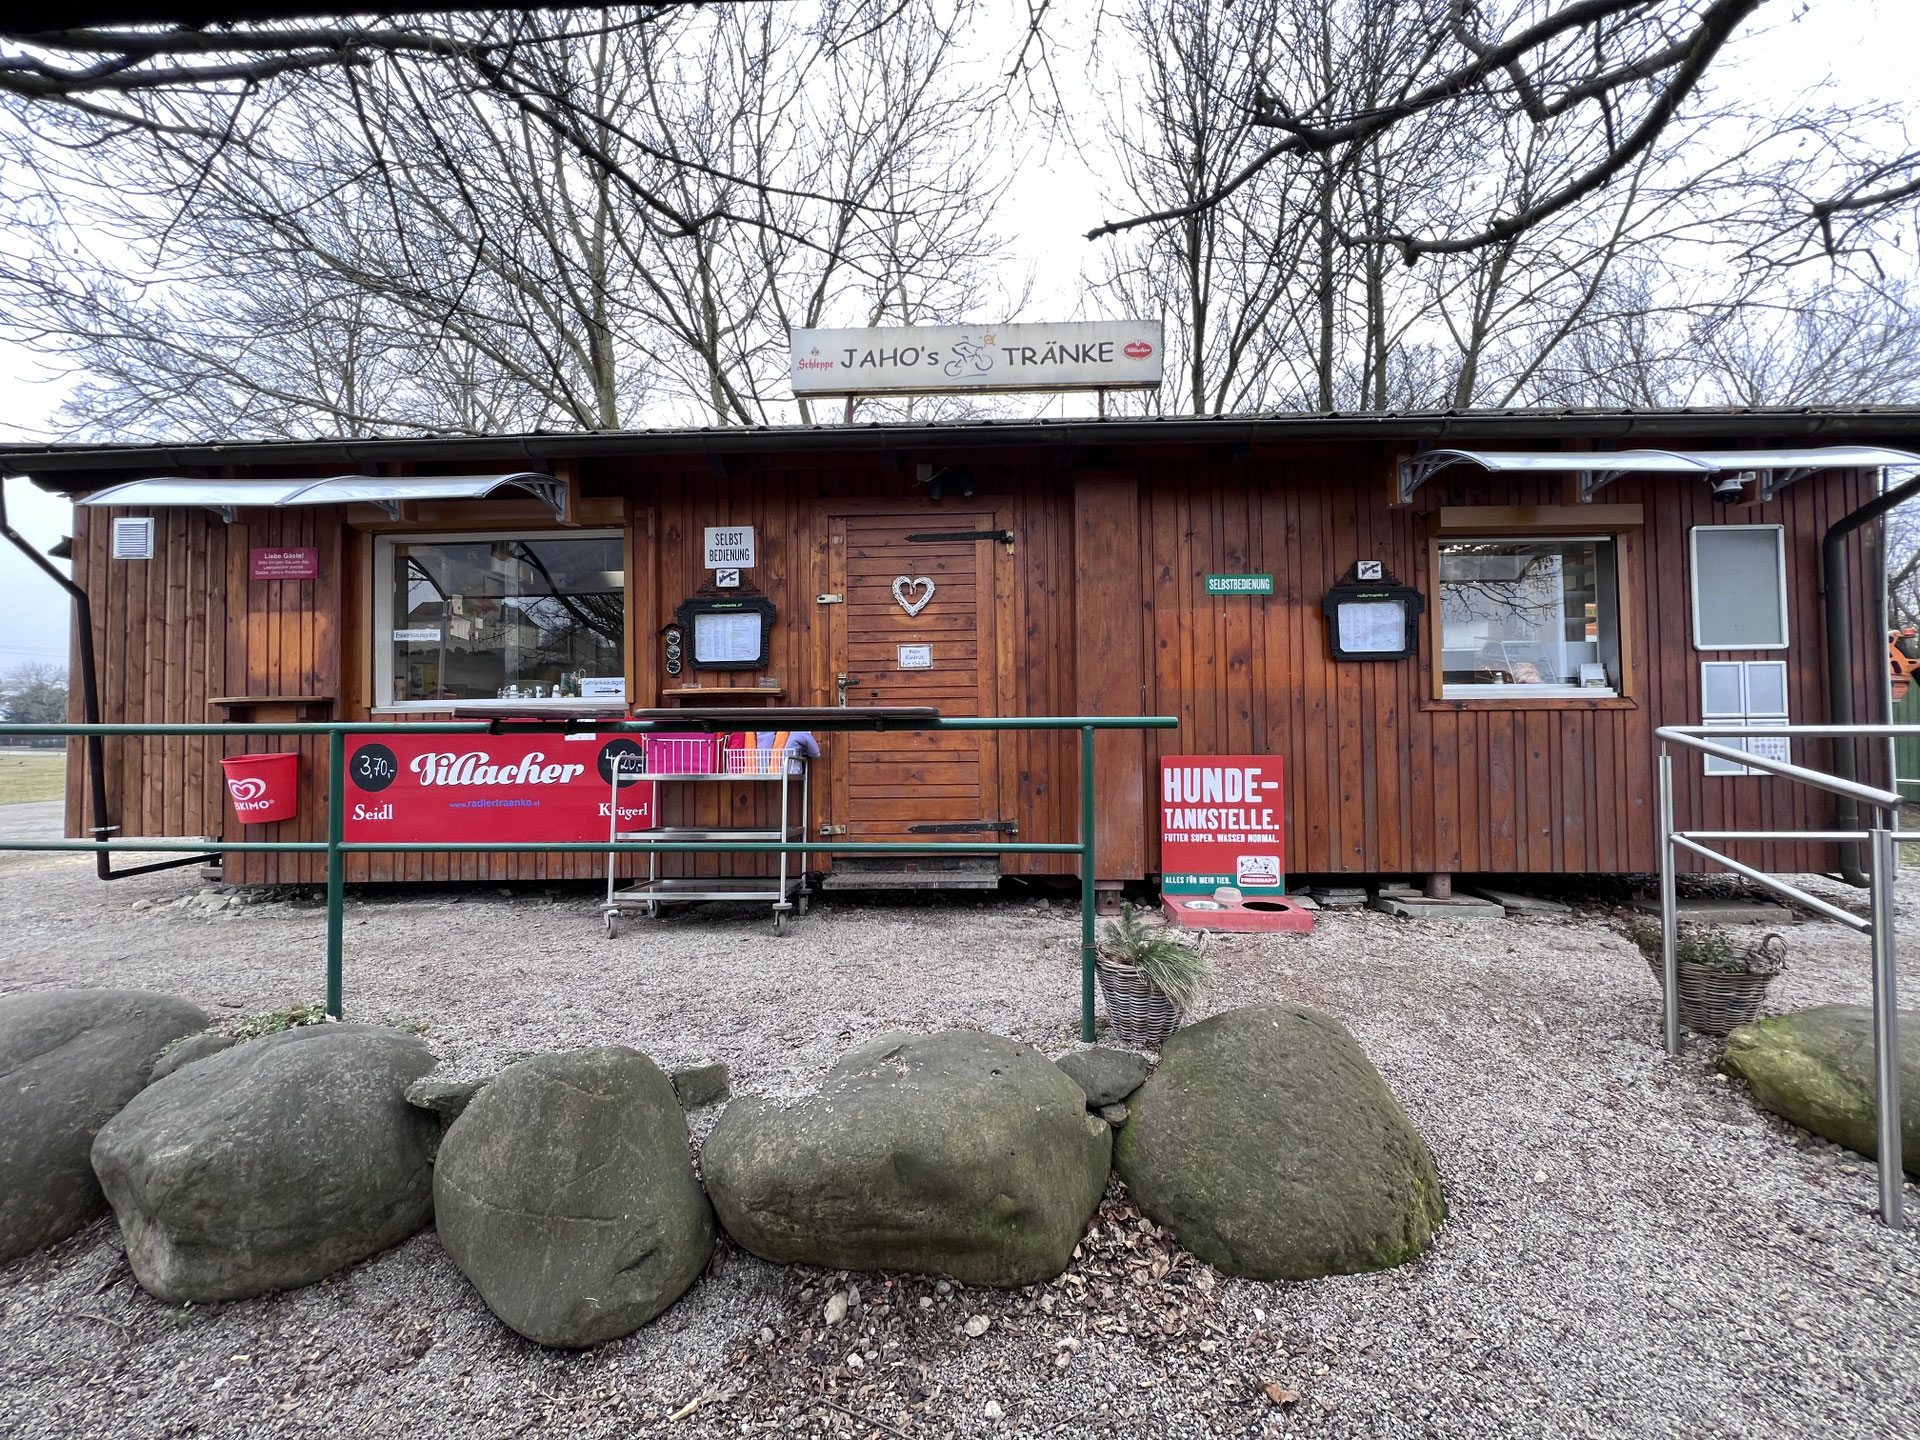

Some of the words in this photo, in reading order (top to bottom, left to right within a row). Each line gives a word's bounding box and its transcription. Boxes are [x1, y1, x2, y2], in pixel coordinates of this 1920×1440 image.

[840, 345, 939, 368] JAHO's
[1001, 341, 1114, 366] TRÄNKE
[797, 358, 834, 371] Schleppe
[715, 532, 744, 546] SELBST
[709, 548, 750, 562] BEDIENUNG
[1208, 578, 1270, 590] SELBSTBEDIENUNG
[360, 755, 395, 779] 3,70,-
[409, 751, 585, 786] Villacher
[605, 748, 643, 772] 420,-
[1163, 768, 1279, 803] HUNDE-
[352, 803, 394, 820] Seidl
[1164, 808, 1280, 830] TANKSTELLE.
[1164, 833, 1189, 843] FUTTER
[1190, 833, 1215, 843] SUPER.
[1217, 833, 1246, 843] WASSER
[1247, 833, 1280, 843] NORMAL.
[1165, 876, 1184, 885] ALLES
[1186, 874, 1198, 884] FÜR
[1199, 876, 1215, 884] MEIN
[1216, 876, 1231, 885] TIER.
